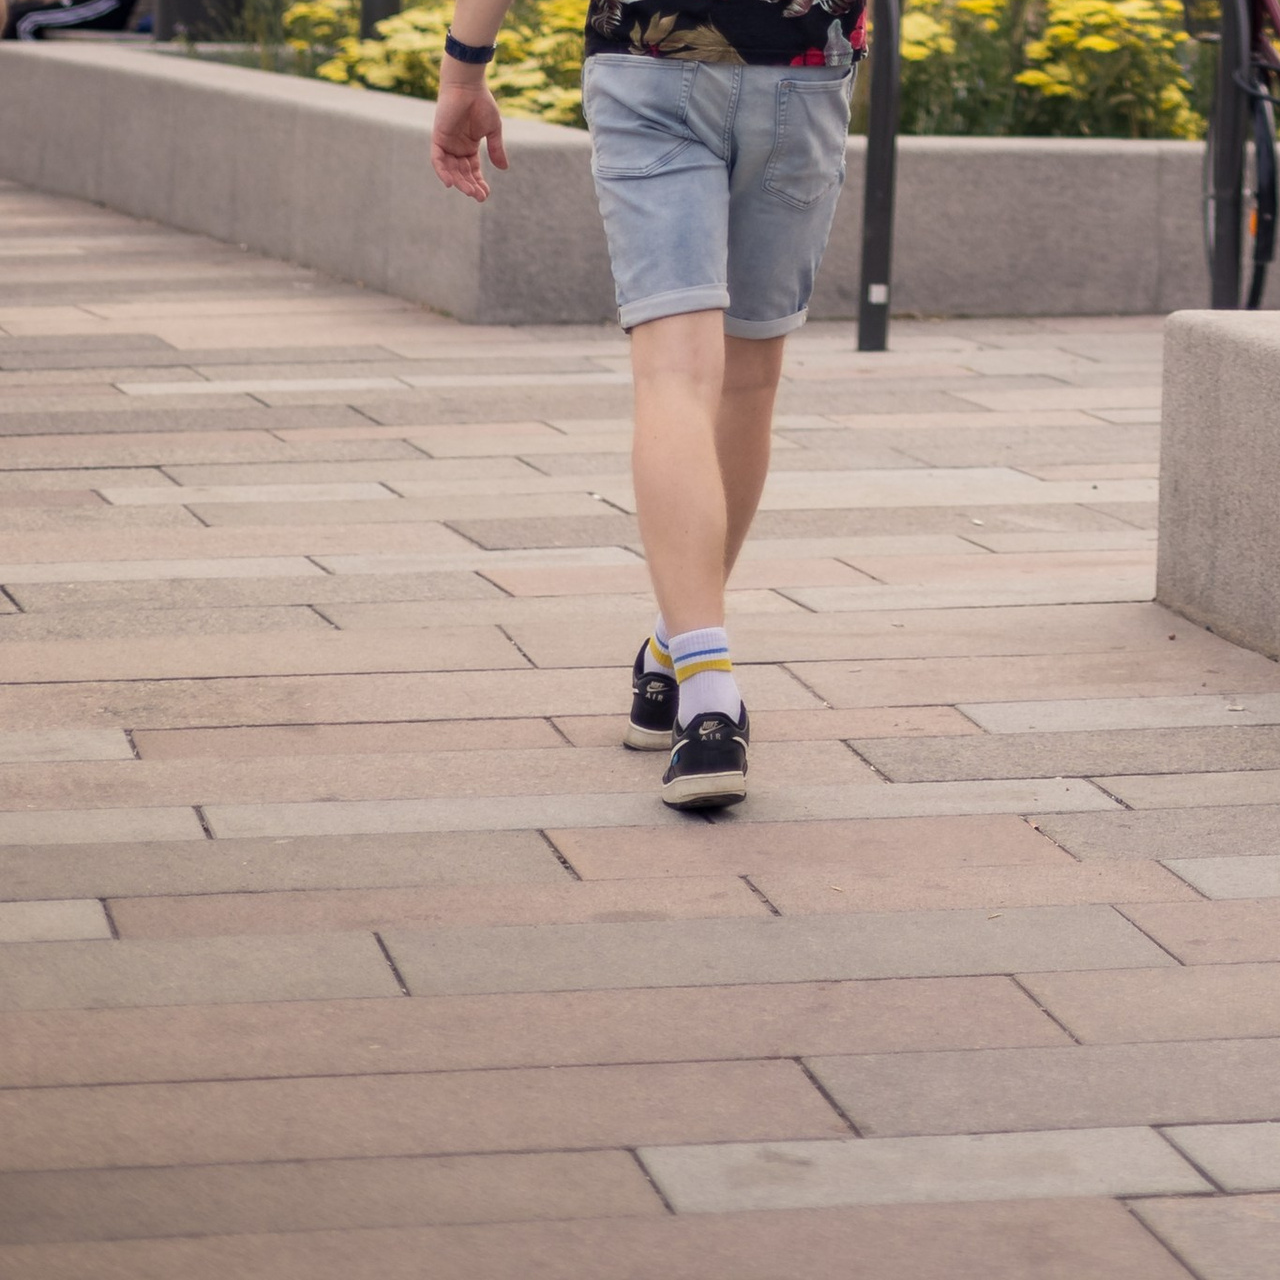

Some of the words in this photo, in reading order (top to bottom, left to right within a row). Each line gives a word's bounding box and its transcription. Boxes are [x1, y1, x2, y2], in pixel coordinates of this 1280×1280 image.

[645, 693, 664, 701] AIR
[702, 721, 719, 729] NIKE
[701, 733, 720, 741] AIR
